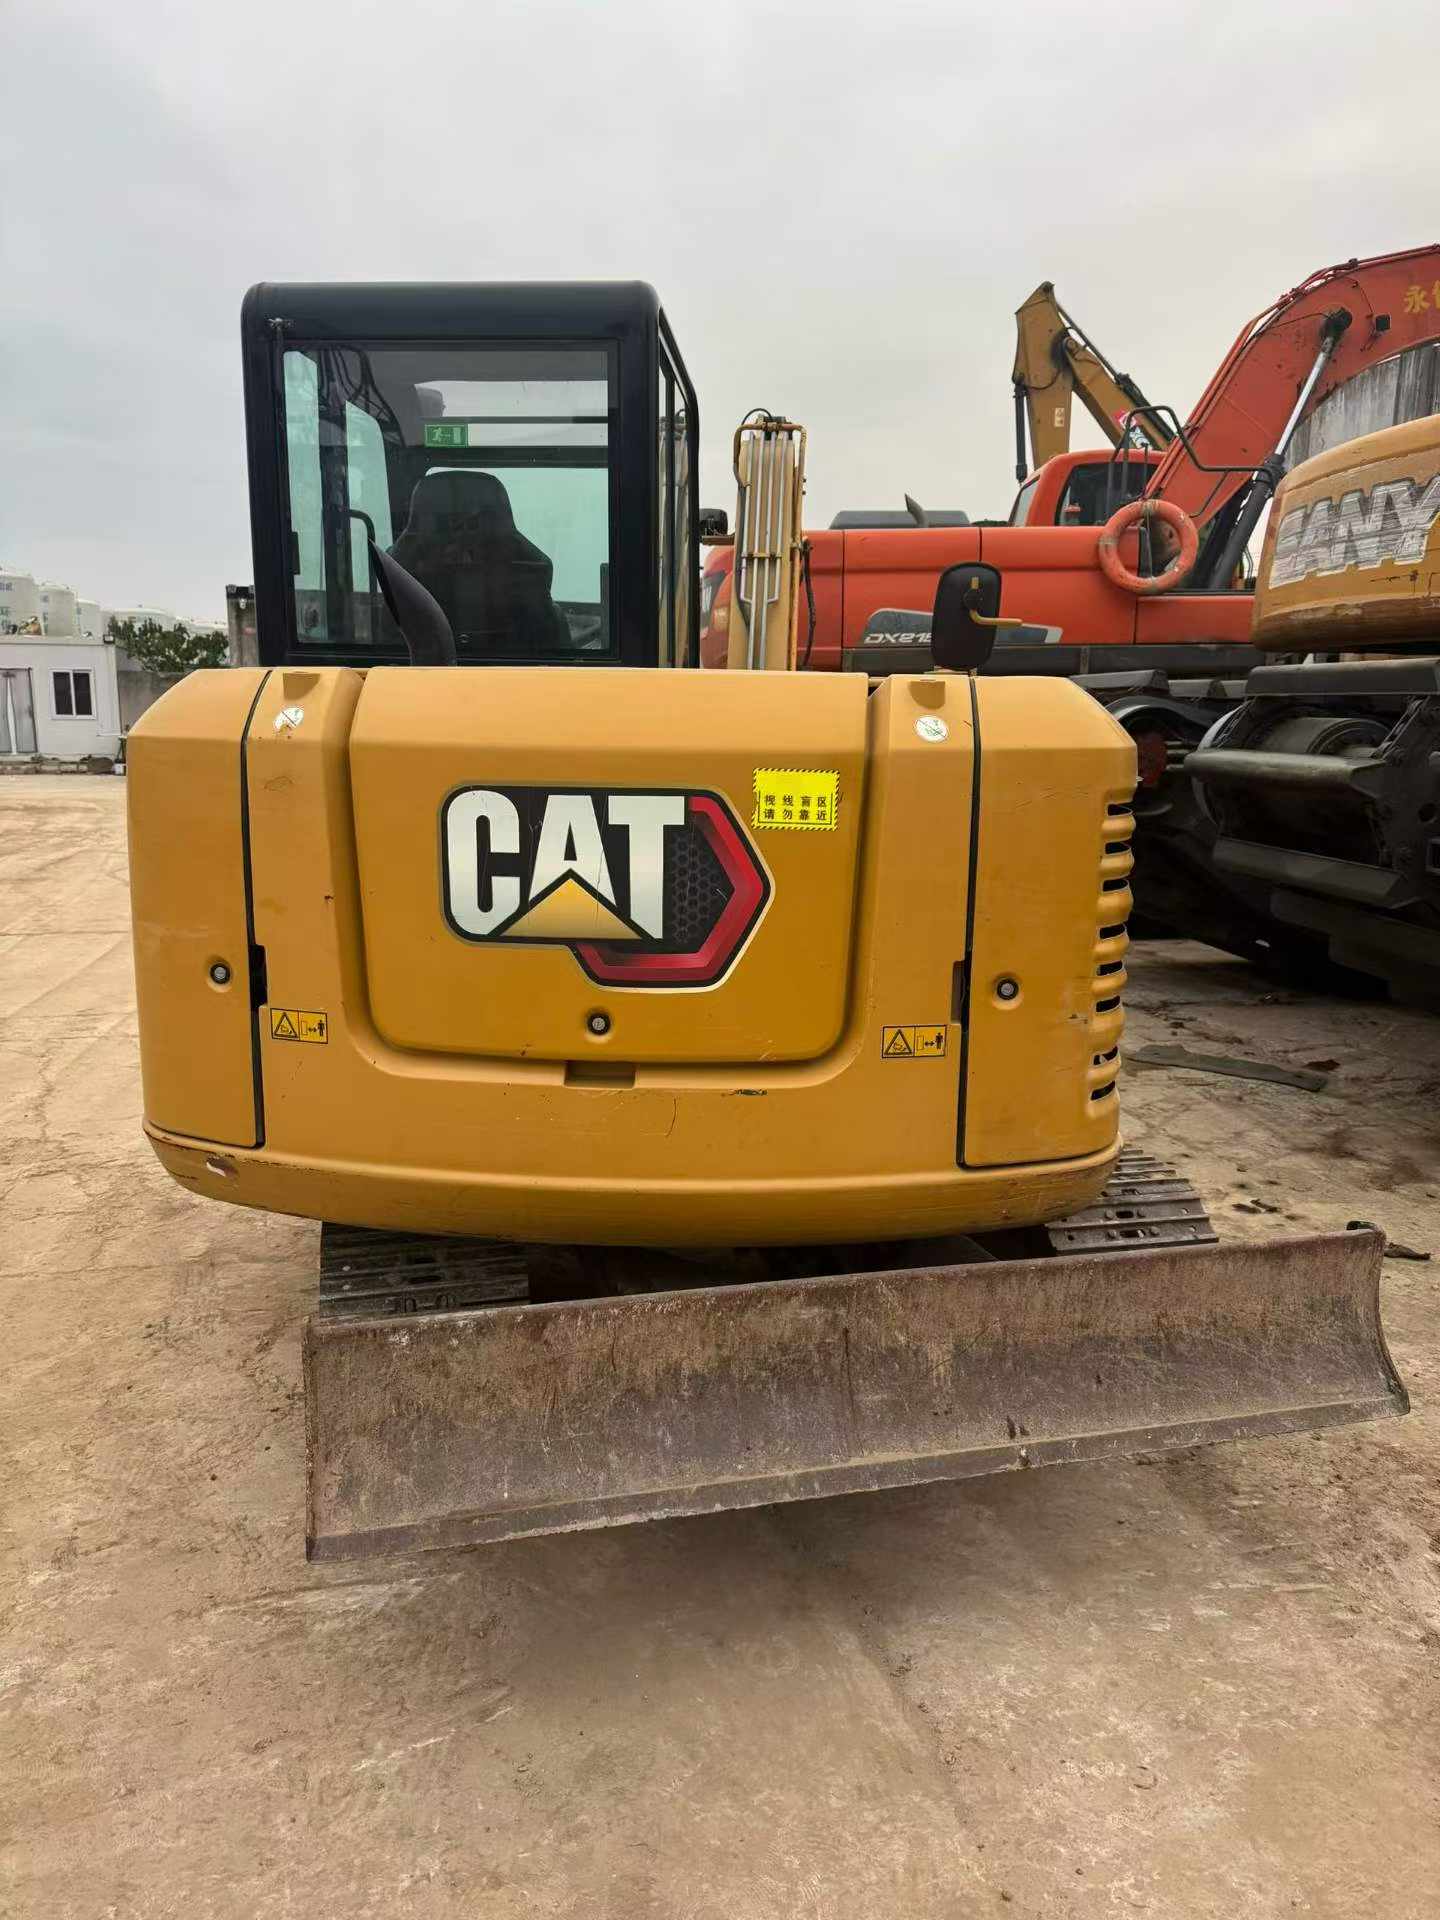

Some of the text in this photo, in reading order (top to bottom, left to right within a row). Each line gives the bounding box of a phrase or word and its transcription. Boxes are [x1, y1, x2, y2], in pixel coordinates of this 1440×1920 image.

[763, 808, 827, 821] 请勿靠近
[447, 790, 685, 939] CAT
